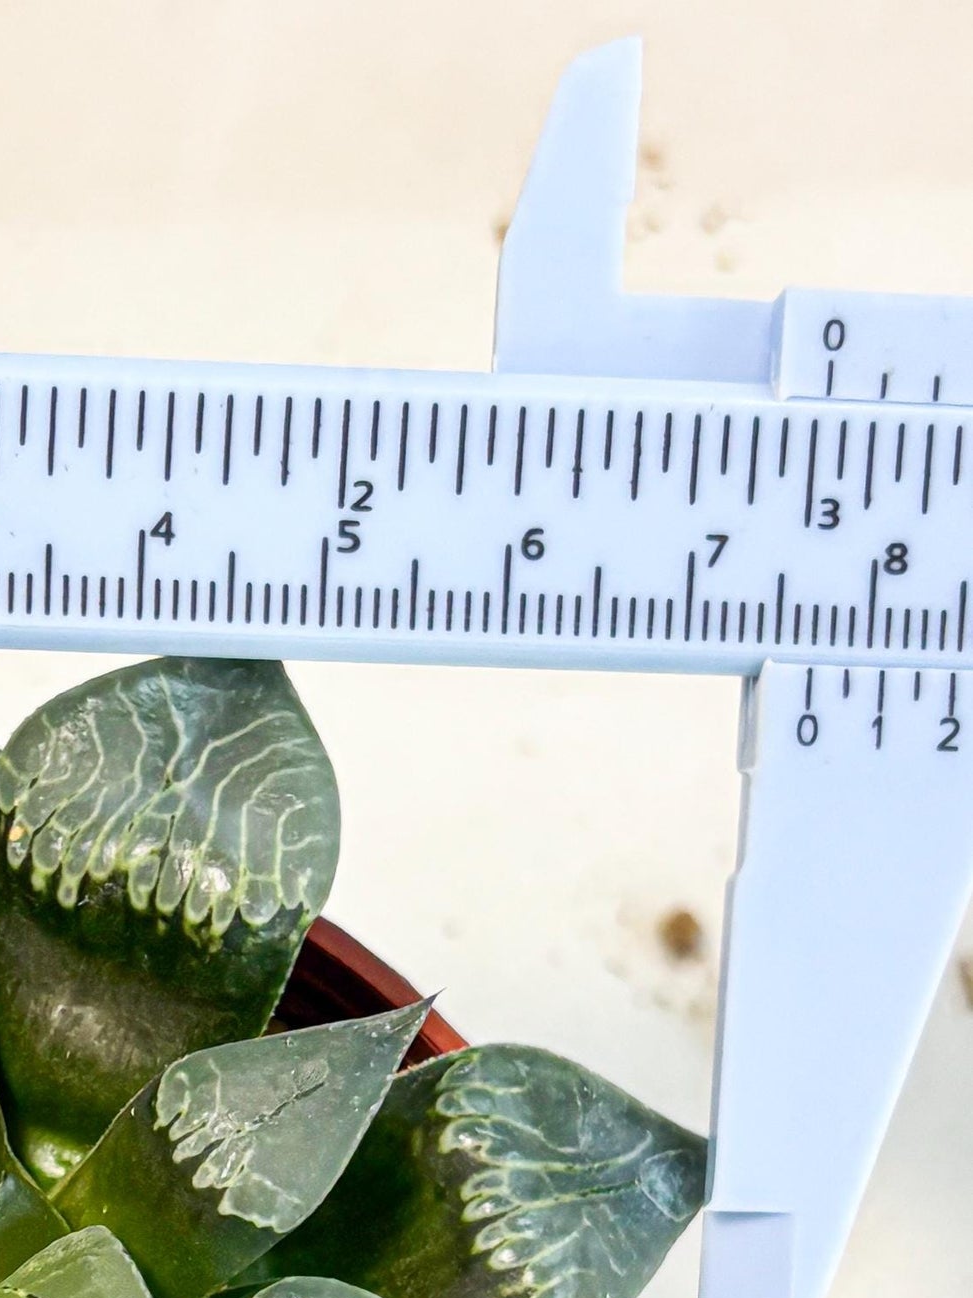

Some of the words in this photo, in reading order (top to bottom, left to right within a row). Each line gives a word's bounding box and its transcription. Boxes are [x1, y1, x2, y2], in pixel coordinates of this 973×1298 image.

[822, 318, 846, 352] 0
[349, 480, 374, 513] 2
[817, 497, 841, 531] 3
[149, 511, 176, 547] 4
[336, 519, 361, 554] 5
[520, 527, 546, 562] 6
[705, 533, 730, 568] 7
[882, 542, 909, 576] 8
[796, 713, 819, 747] 0
[871, 714, 884, 750] 1
[936, 716, 961, 752] 2
